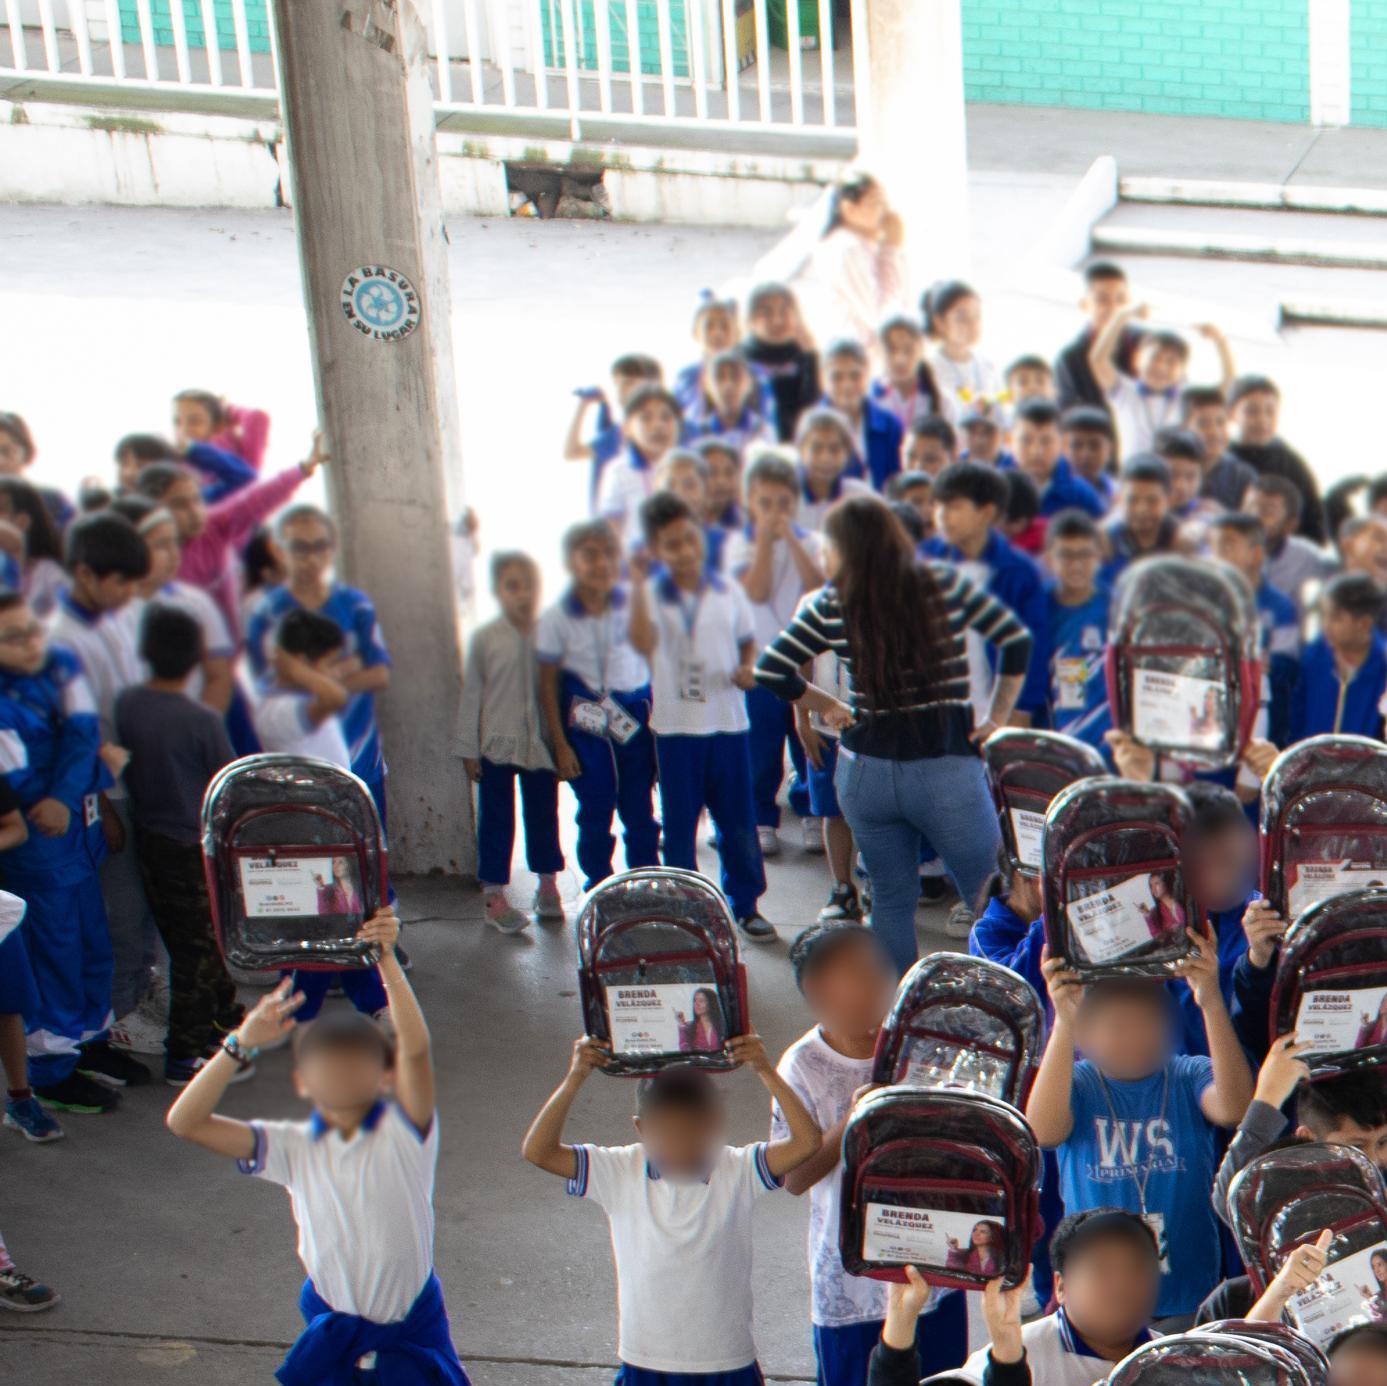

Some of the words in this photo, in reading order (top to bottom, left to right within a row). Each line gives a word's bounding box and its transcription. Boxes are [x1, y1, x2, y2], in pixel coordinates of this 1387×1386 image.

[343, 276, 359, 296] LA
[362, 267, 417, 315] BASURA
[342, 302, 355, 318] EN
[353, 320, 371, 336] SU
[374, 319, 415, 339] LUGAR
[618, 990, 656, 998] BRENDA
[1313, 995, 1350, 1003] BRENDA
[882, 1209, 929, 1221] BRENDA
[877, 1217, 933, 1229] VELÁZQUEZ
